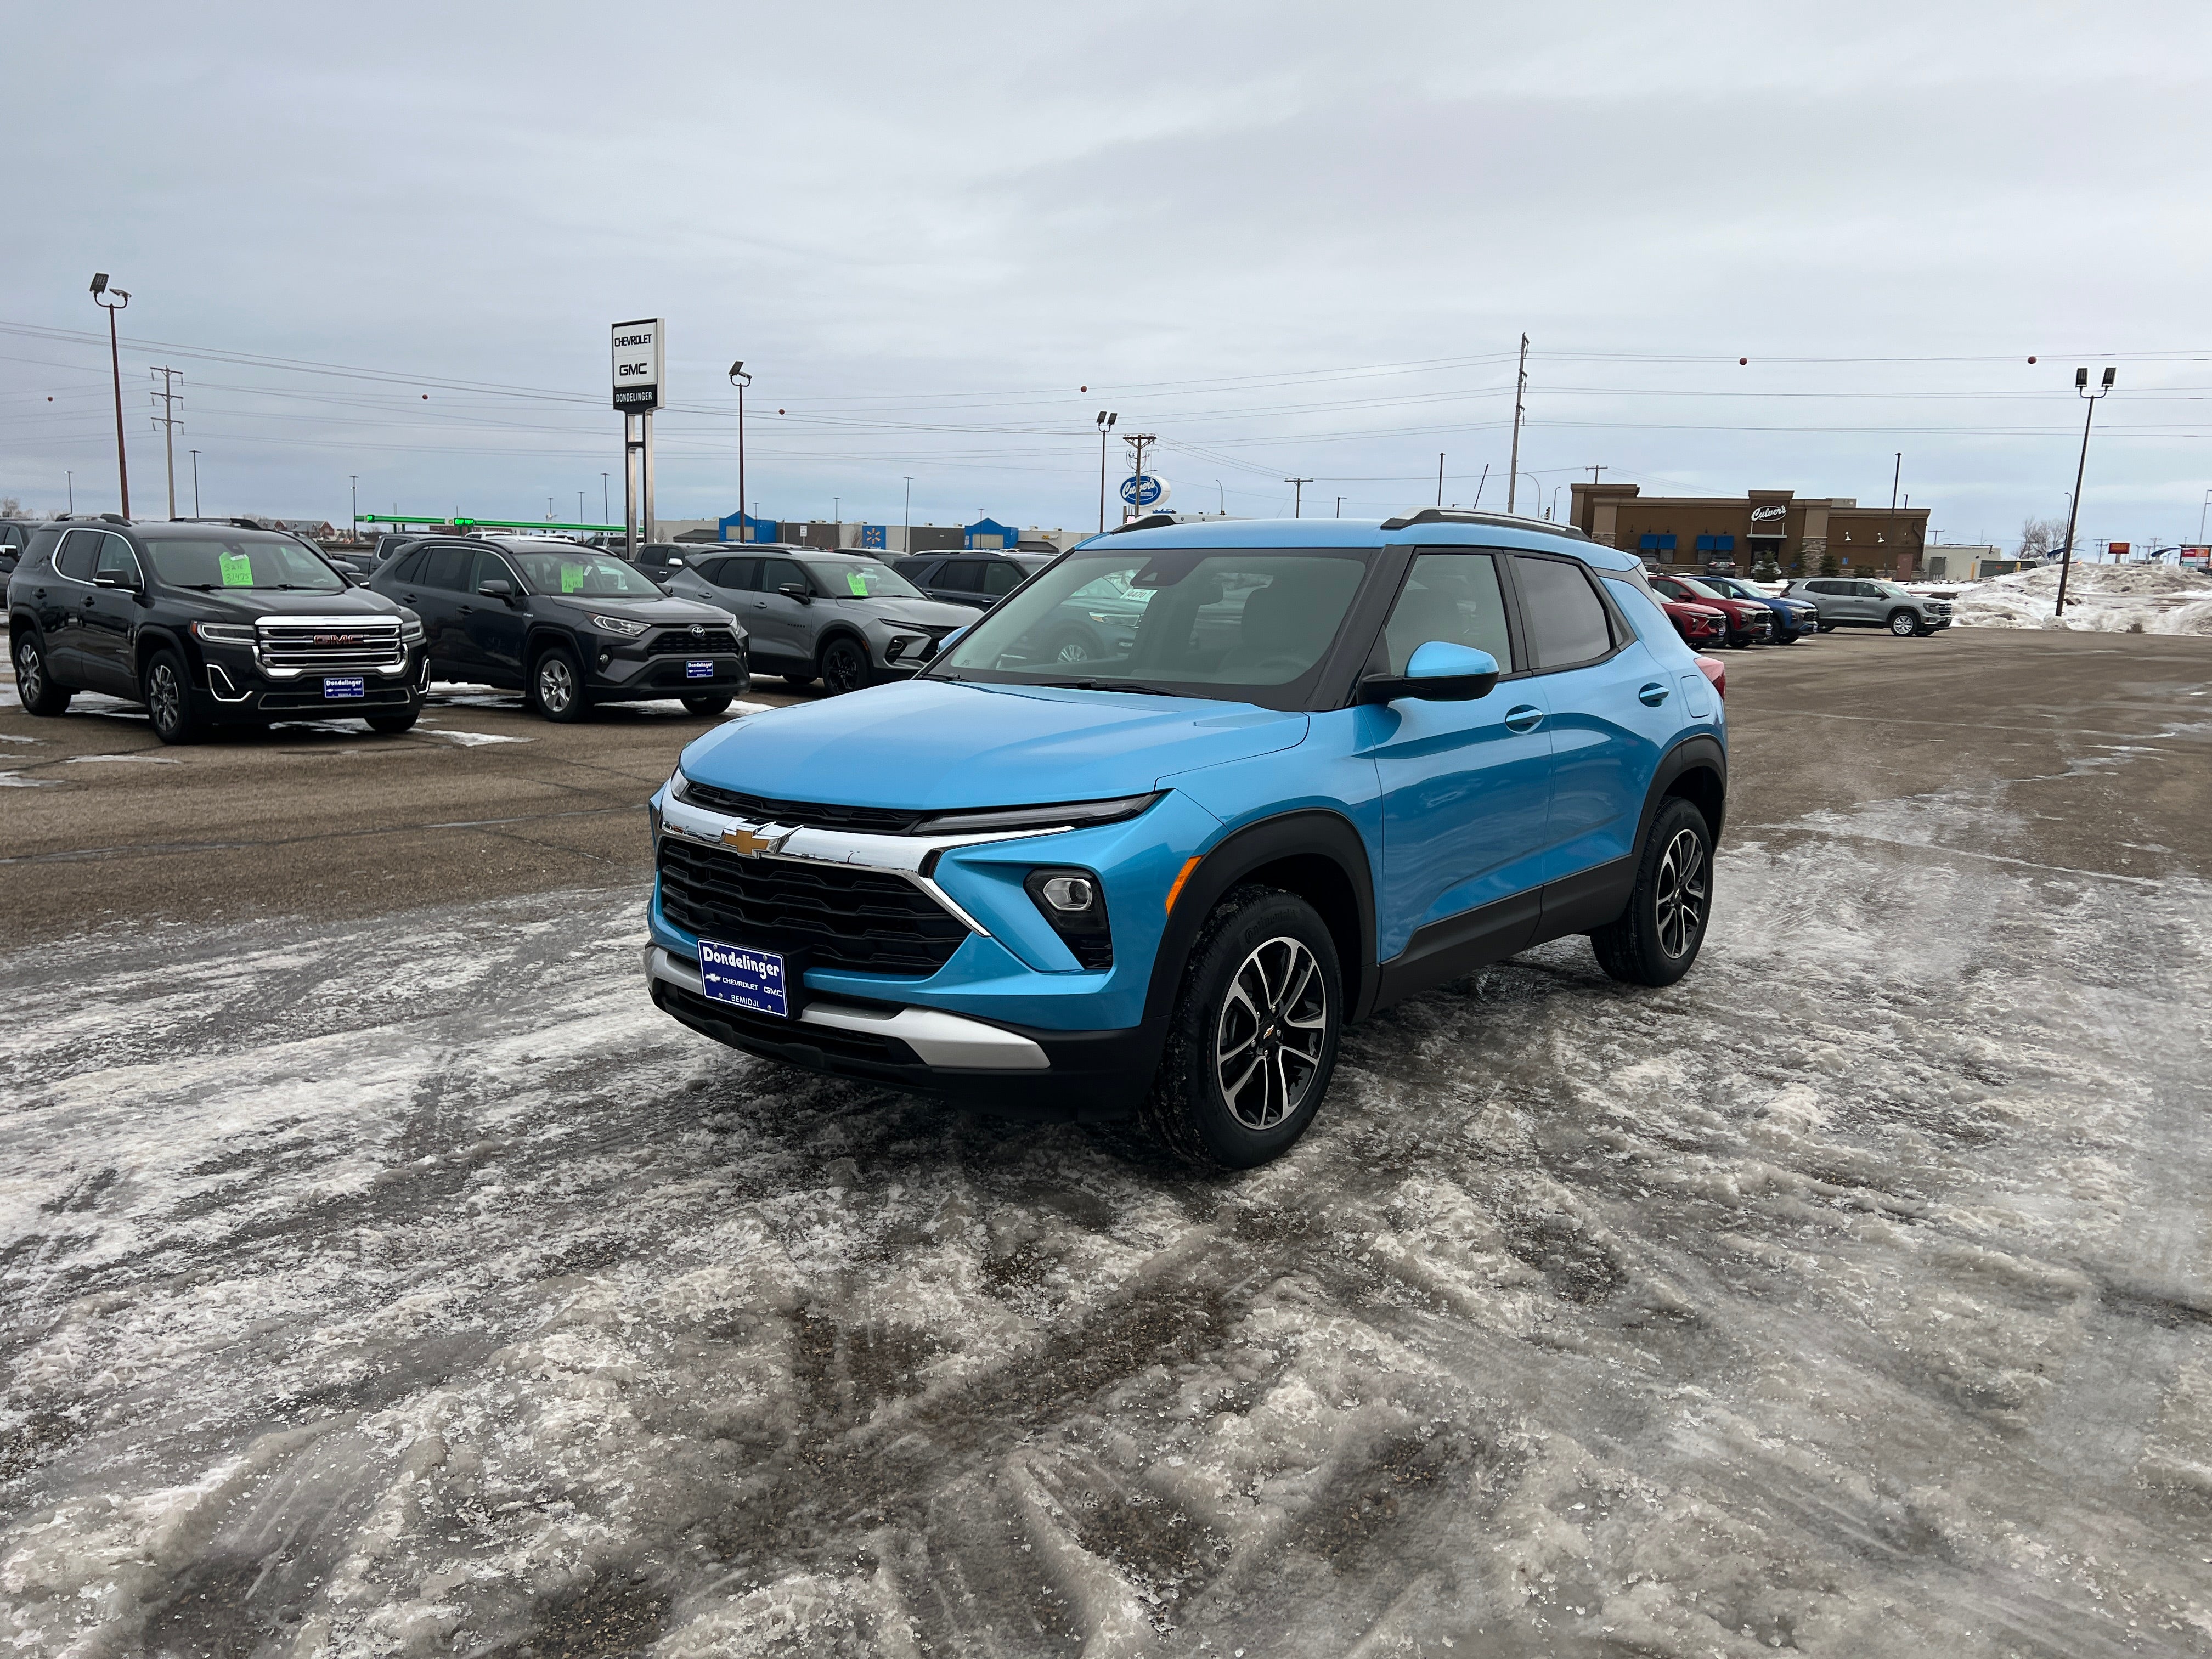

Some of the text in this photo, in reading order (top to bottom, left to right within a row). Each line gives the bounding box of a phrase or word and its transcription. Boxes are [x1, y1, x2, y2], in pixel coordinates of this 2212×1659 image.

[614, 334, 652, 347] CHEVROLET
[619, 362, 647, 376] GMC
[616, 391, 652, 403] DONDELINGER
[1751, 505, 1787, 521] Culver's
[314, 634, 363, 645] GMC
[702, 946, 780, 980] Dondelinger
[722, 977, 783, 997] CHEVROLET GMC
[731, 994, 759, 1008] BEMIDJI
